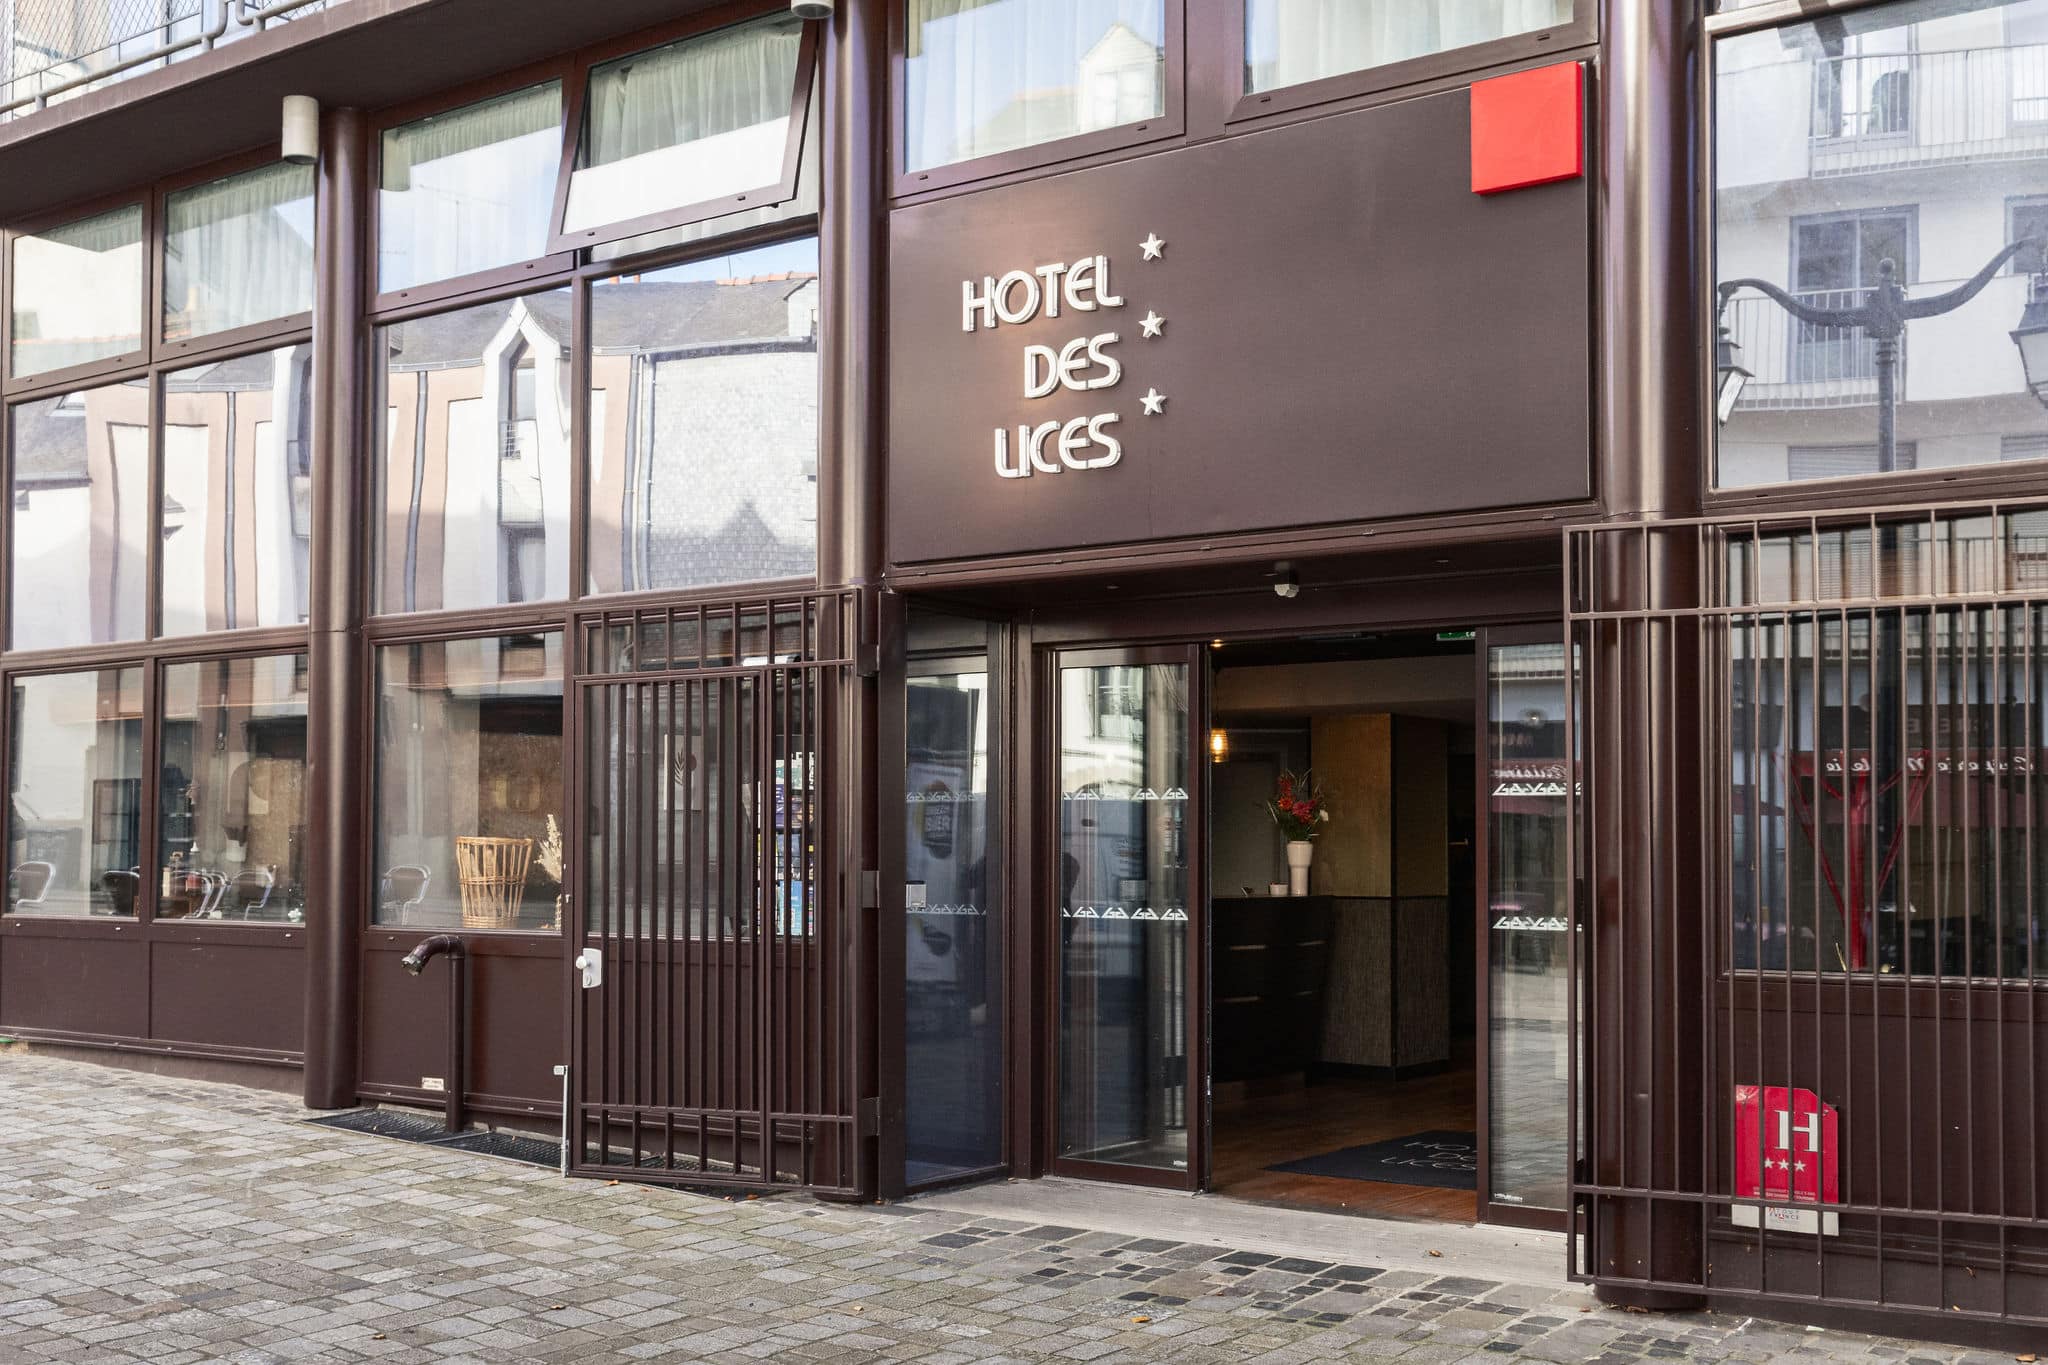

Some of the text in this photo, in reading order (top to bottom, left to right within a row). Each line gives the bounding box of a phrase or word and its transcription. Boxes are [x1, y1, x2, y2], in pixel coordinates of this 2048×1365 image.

[962, 255, 1124, 332] HOTEL
[1024, 332, 1121, 398] DES
[994, 412, 1121, 478] LICES
[1774, 1109, 1820, 1153] H
